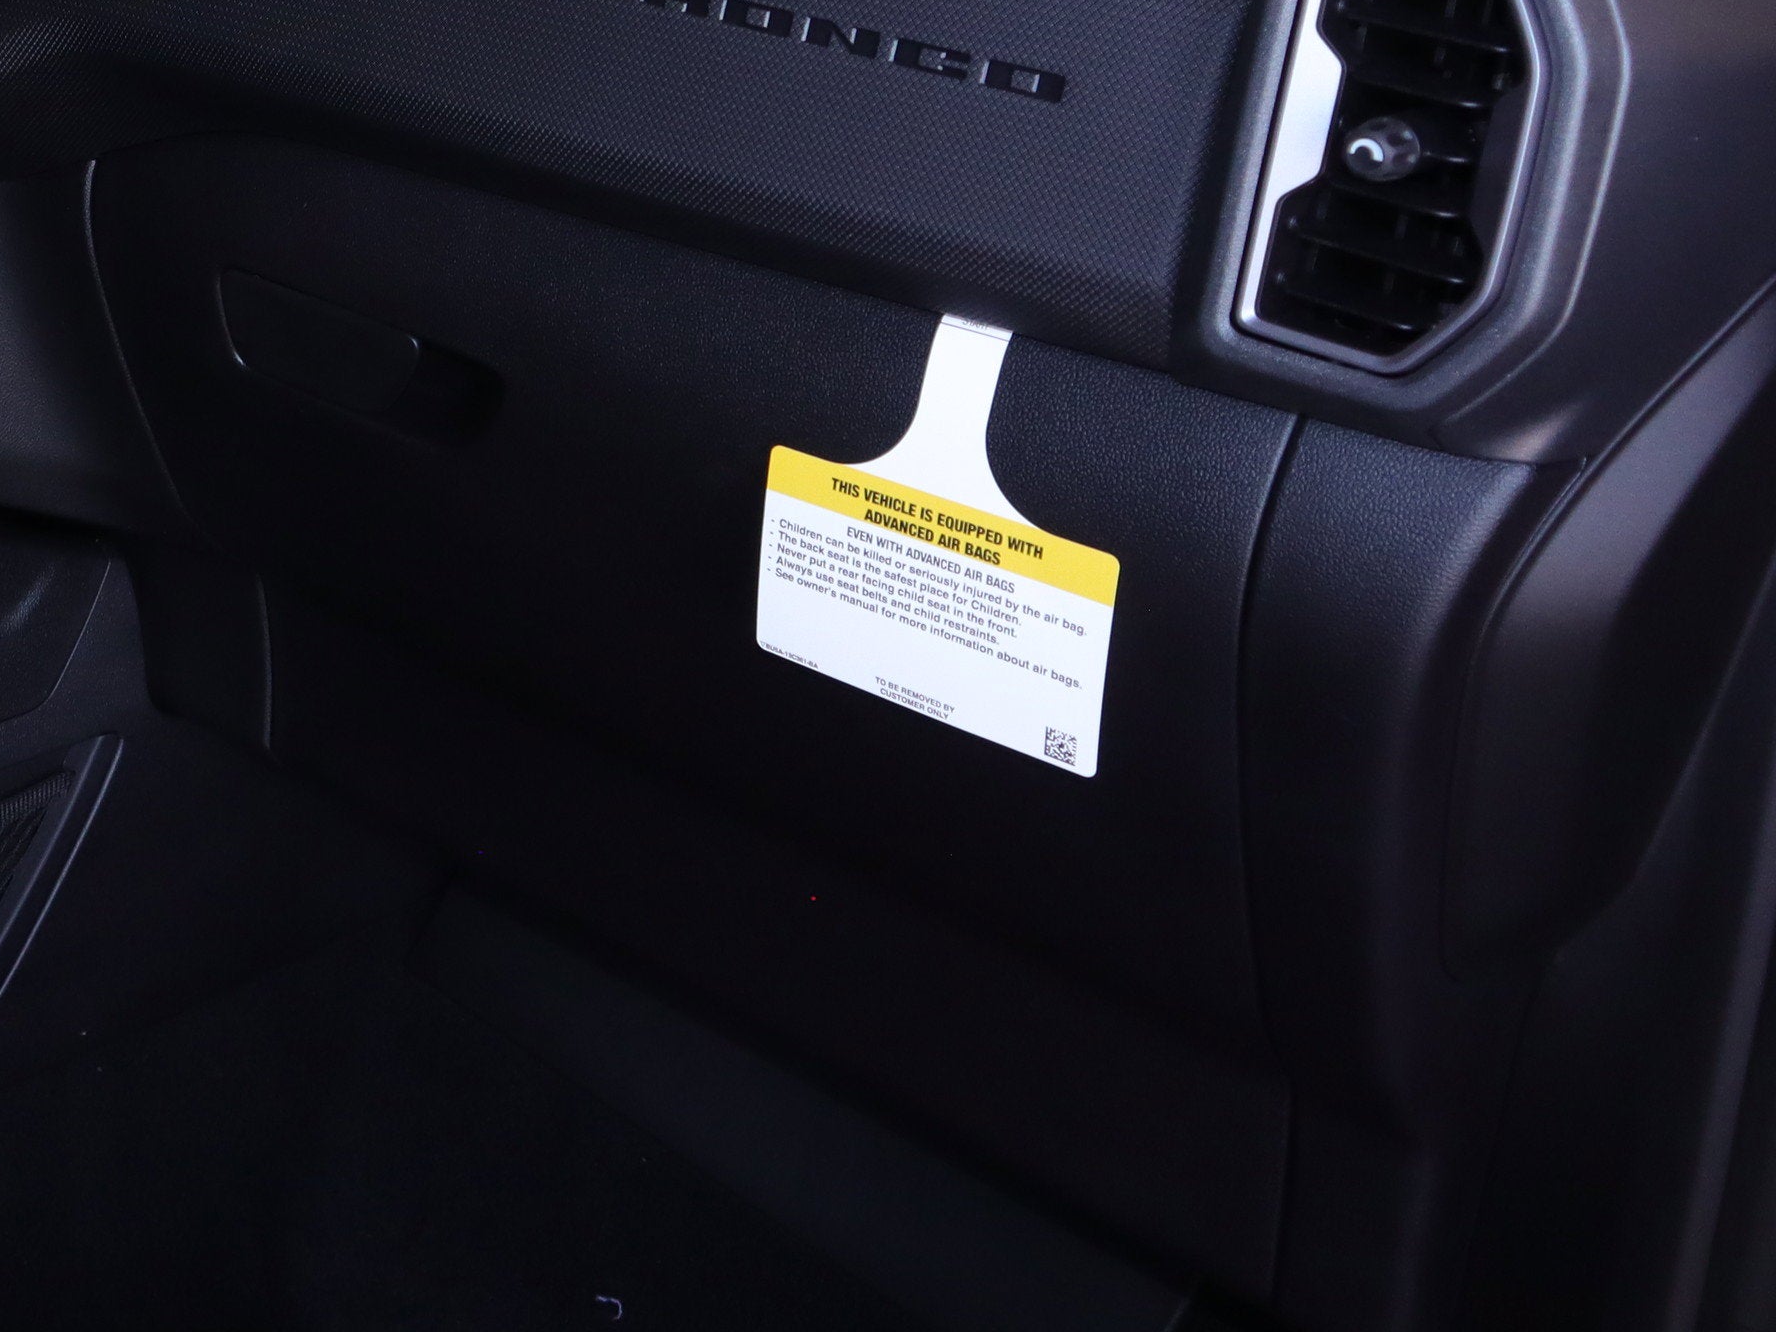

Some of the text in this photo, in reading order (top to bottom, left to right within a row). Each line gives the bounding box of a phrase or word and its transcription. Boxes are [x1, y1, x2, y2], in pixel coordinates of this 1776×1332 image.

[831, 477, 1044, 560] THIS VEHICLE IS EQUIPPED WITH
[846, 526, 1016, 594] EVEN WITH ADVANCED AIR BAGS
[864, 508, 1002, 566] ADVANCED AIR BAGS
[776, 556, 1000, 645] Always use seat belts and child restraints.
[777, 543, 1017, 638] Never put a rear facing child seat in the front.
[778, 530, 1022, 626] The back seat is the safest place for Children.
[779, 518, 1087, 637] Children can be killed or seriously injured by the air bag.
[775, 567, 1082, 689] See owner's manual for more information about air bags.
[875, 676, 955, 714] TO BE REMOVED BY
[880, 687, 949, 720] CUSTOMER ONLY
